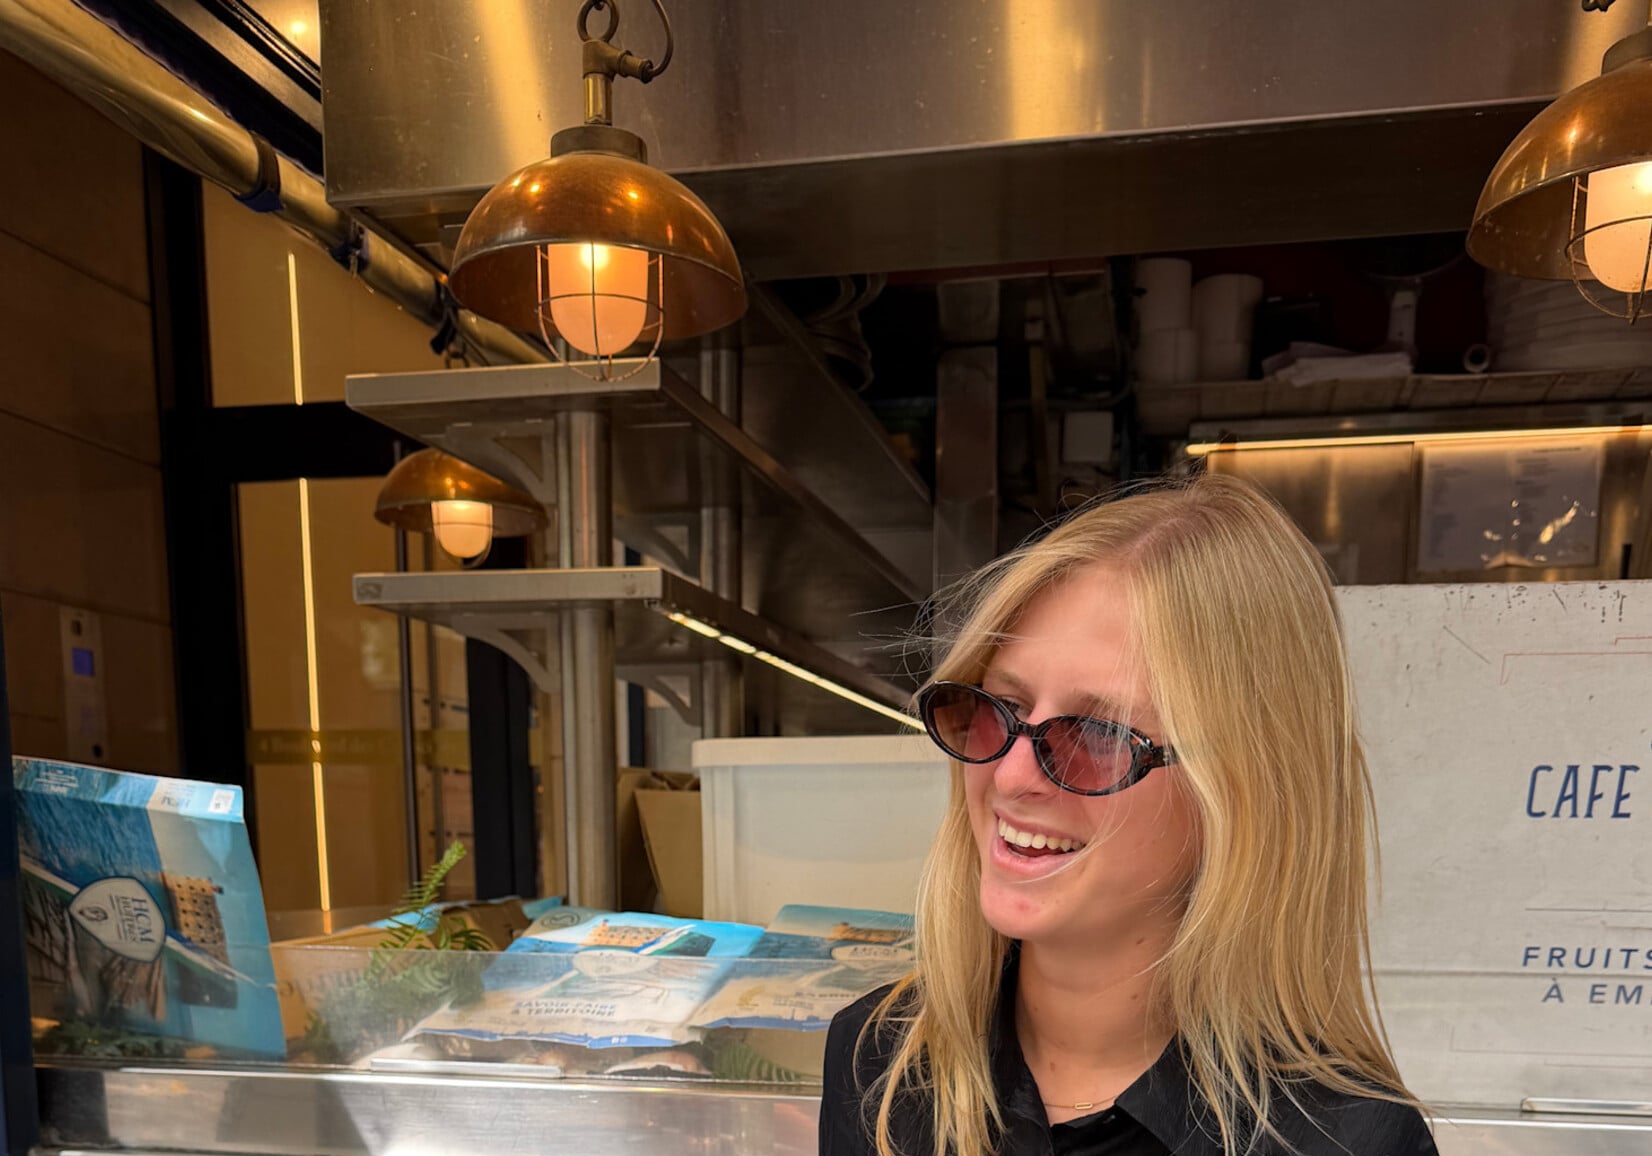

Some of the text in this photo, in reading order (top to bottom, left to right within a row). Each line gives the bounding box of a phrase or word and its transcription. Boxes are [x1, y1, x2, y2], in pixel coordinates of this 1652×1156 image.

[1526, 764, 1641, 819] CAFE
[1522, 946, 1652, 970] FRUITS
[1541, 976, 1652, 1005] À EM
